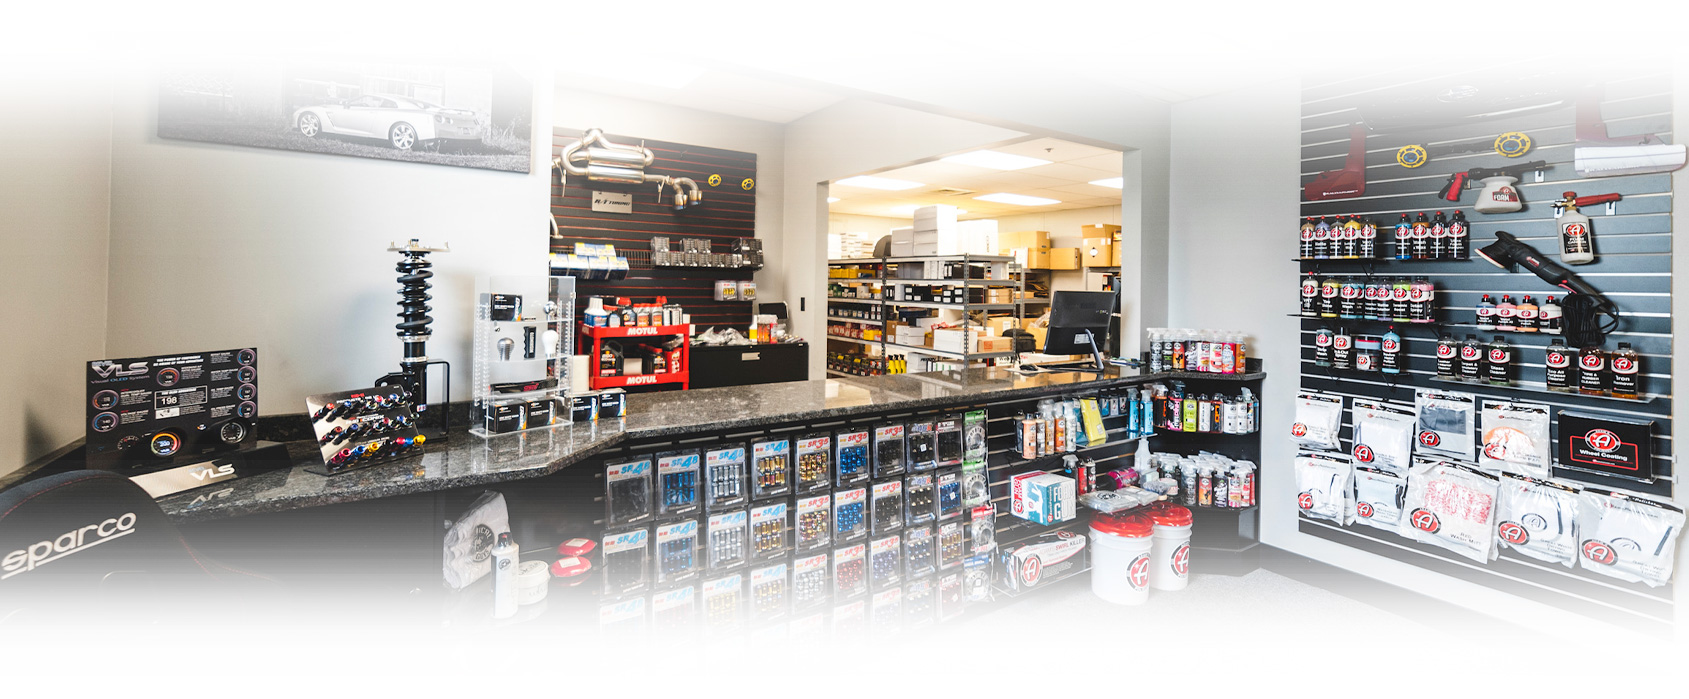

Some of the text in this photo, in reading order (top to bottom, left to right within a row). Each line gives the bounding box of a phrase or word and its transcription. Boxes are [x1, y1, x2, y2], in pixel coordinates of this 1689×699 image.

[627, 327, 658, 335] MOTUL
[92, 362, 149, 378] VLS
[626, 375, 657, 385] MOTUL
[885, 426, 903, 436] SR35
[808, 438, 829, 448] SR35
[848, 433, 867, 443] SR35
[765, 440, 788, 452] SR48
[719, 448, 744, 461] SR48
[1580, 449, 1600, 457] Wheel
[1601, 452, 1628, 462] Coating
[621, 460, 650, 474] SR48
[670, 455, 698, 468] SR48
[190, 464, 235, 480] VLS
[882, 482, 900, 492] SR35
[845, 489, 865, 500] SR35
[808, 497, 829, 507] SR35
[670, 522, 696, 534] SR48
[1, 512, 136, 571] sparco
[616, 530, 646, 545] SR48
[1450, 534, 1467, 542] WASH
[1056, 542, 1069, 551] SWIRL
[1069, 538, 1085, 546] KILLER
